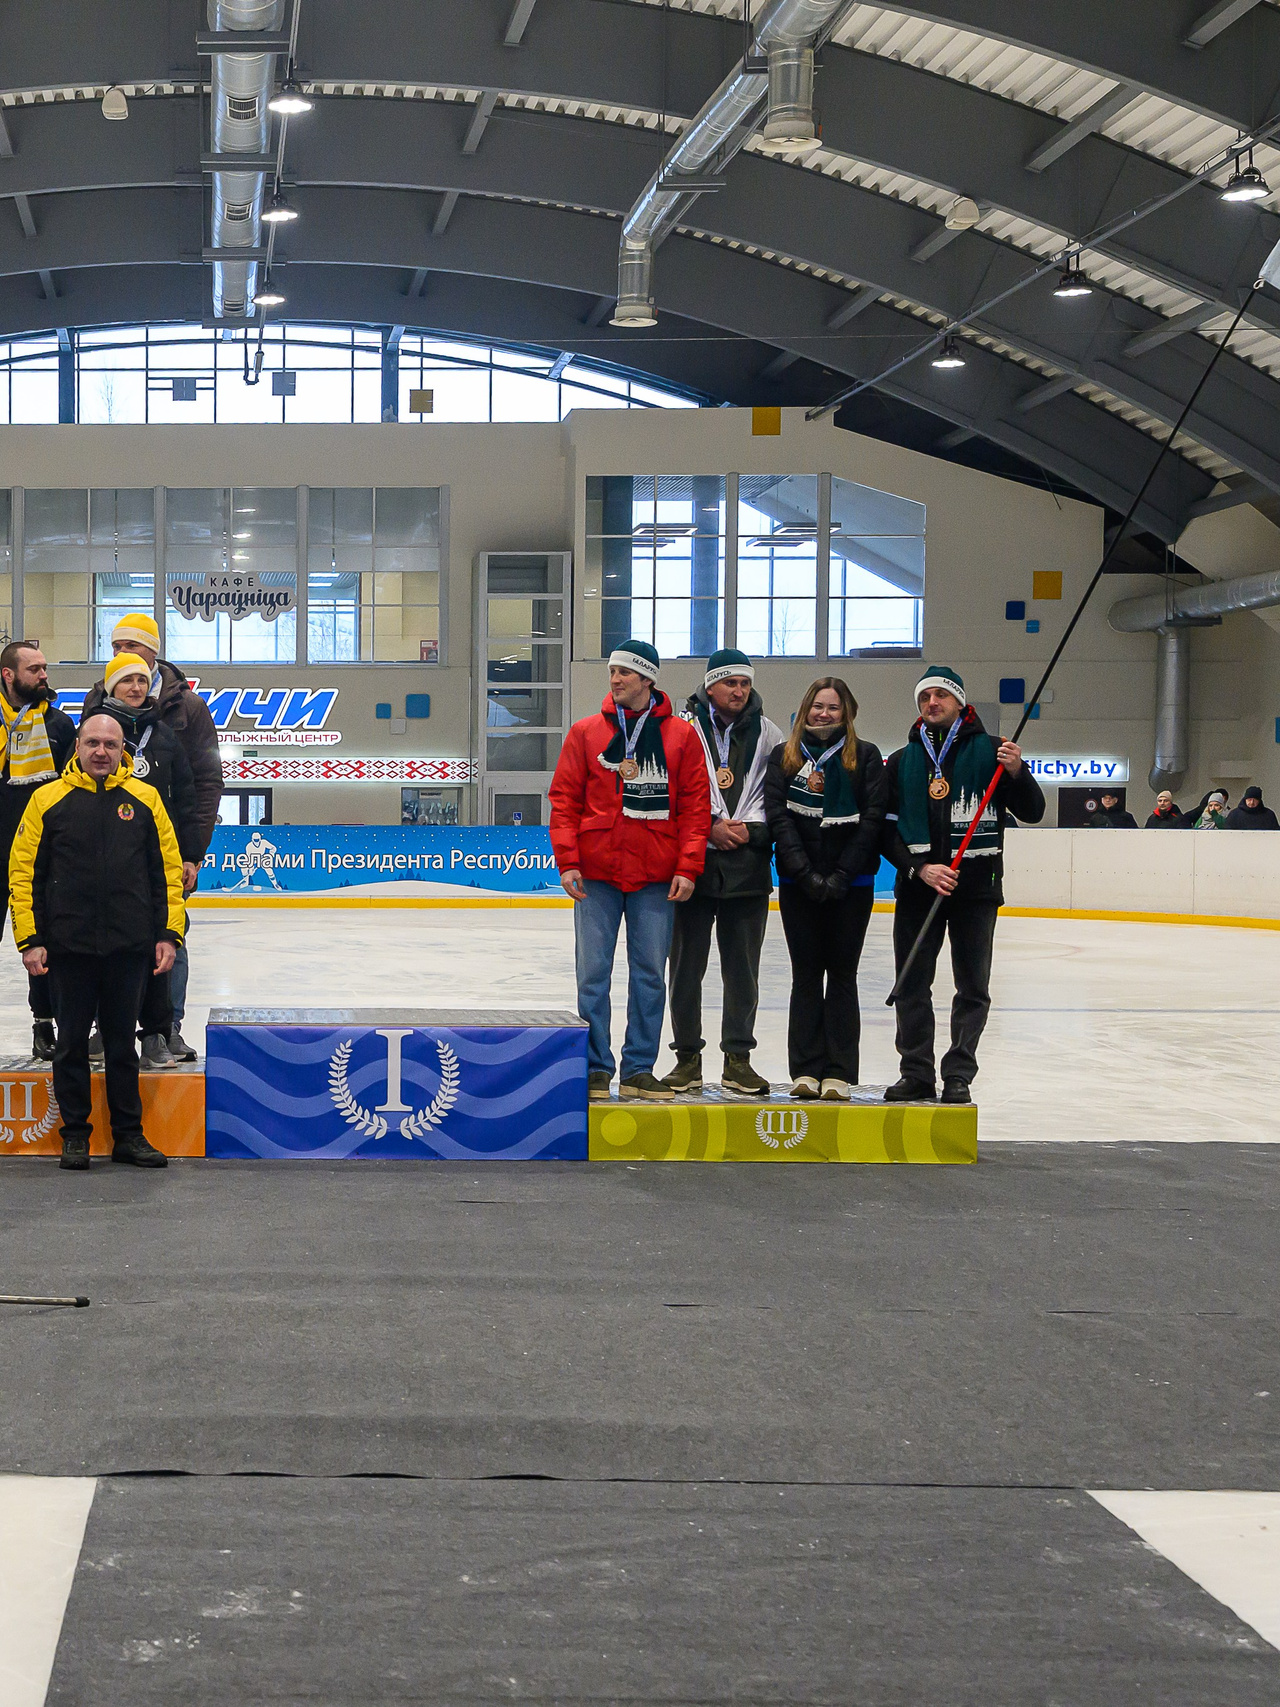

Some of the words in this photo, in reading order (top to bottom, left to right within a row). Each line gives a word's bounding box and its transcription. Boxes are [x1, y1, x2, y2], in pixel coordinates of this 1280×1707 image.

[210, 577, 254, 587] КАФЕ
[172, 585, 292, 617] Чараўніца
[51, 684, 338, 728] СИЧИ
[217, 731, 291, 743] ОЛЫЖНЫЙ
[294, 734, 339, 745] ЦЕНТР
[1024, 760, 1117, 777] lichy.by
[221, 852, 305, 872] делами
[312, 848, 444, 872] Президента
[450, 848, 557, 875] Республи
[375, 1029, 414, 1112] I
[764, 1110, 801, 1134] III
